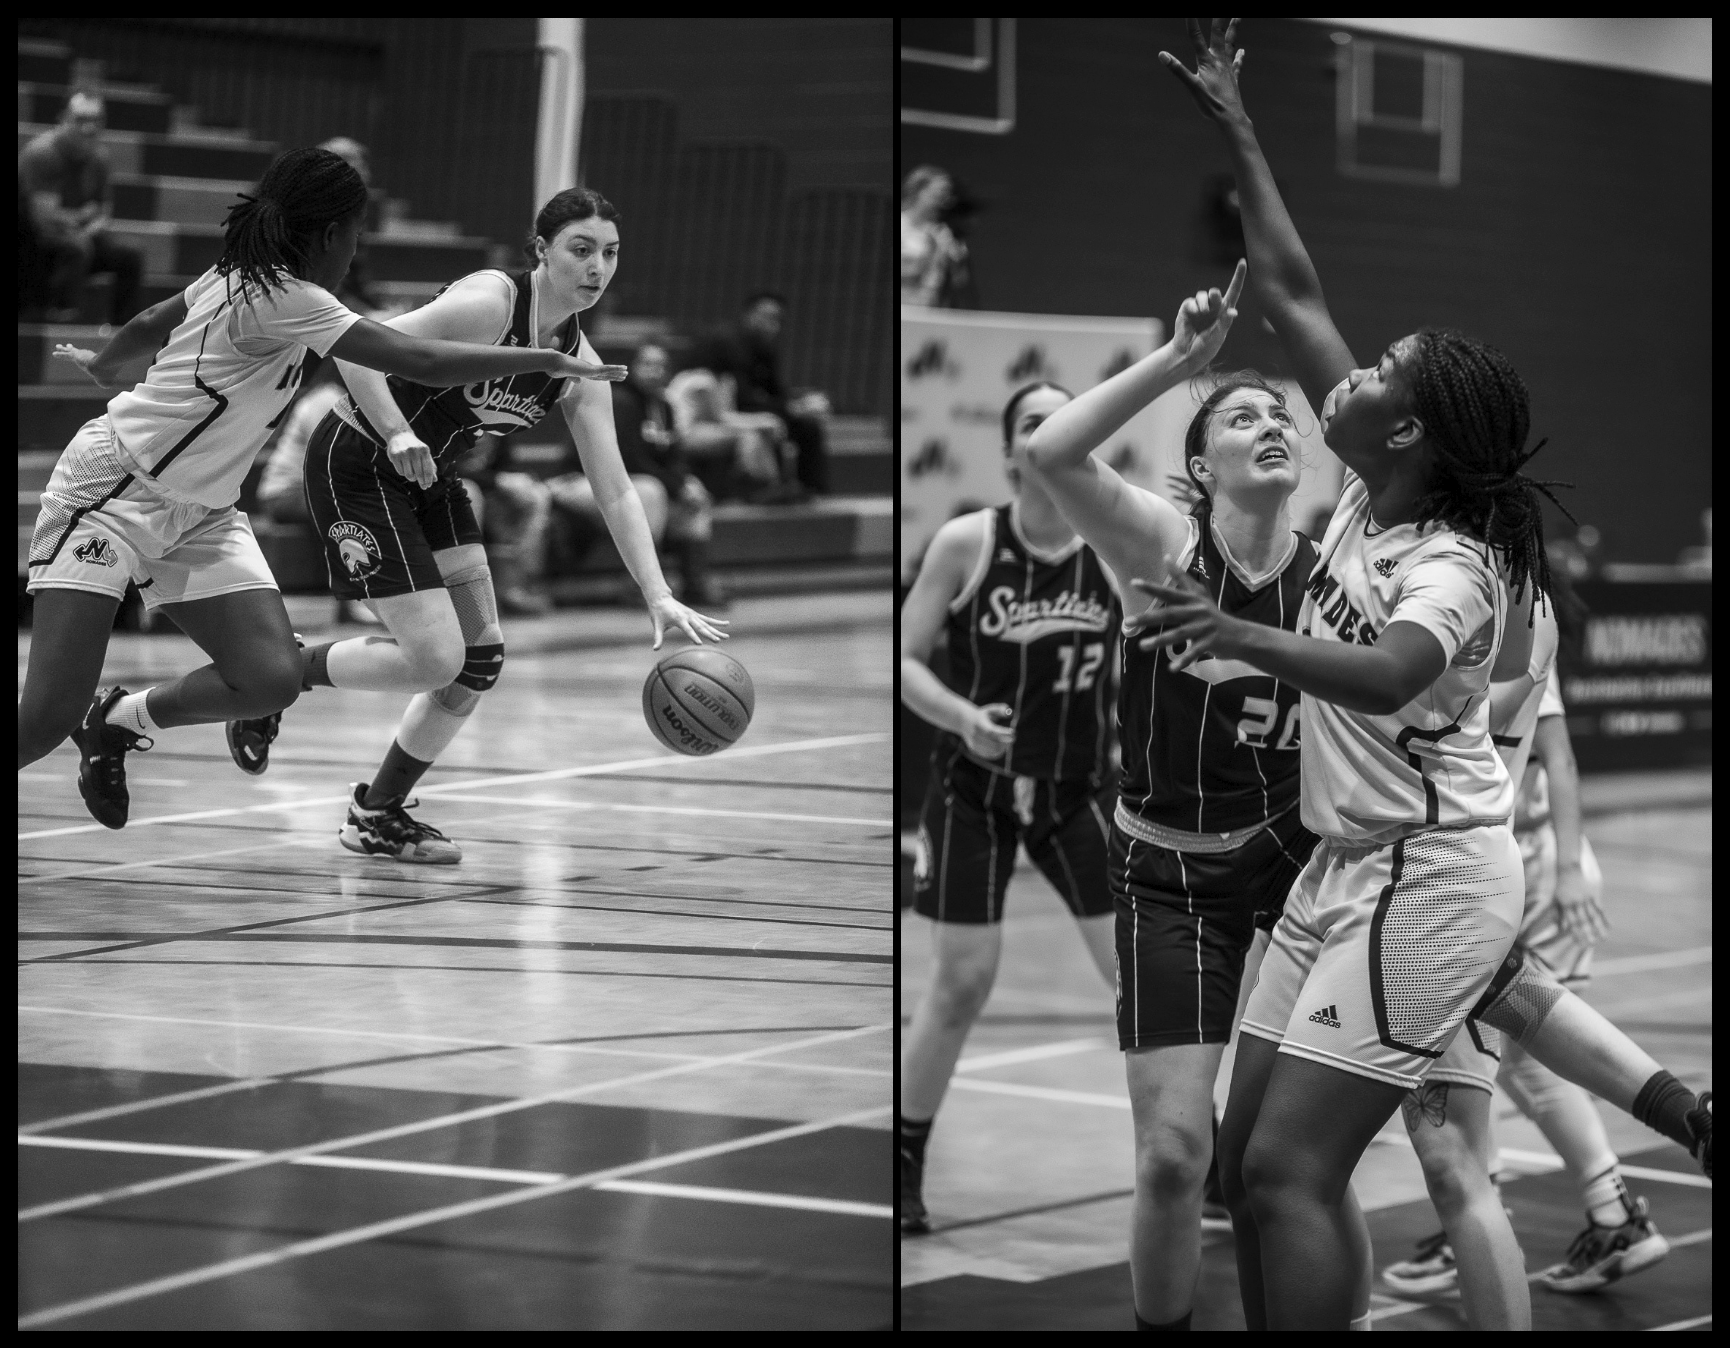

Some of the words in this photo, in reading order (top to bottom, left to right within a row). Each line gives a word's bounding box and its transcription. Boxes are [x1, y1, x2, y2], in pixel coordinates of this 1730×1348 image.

[331, 523, 377, 552] SPARTIATES
[1053, 642, 1104, 693] 12
[662, 703, 720, 754] Wilson
[1309, 1015, 1341, 1029] adidas
